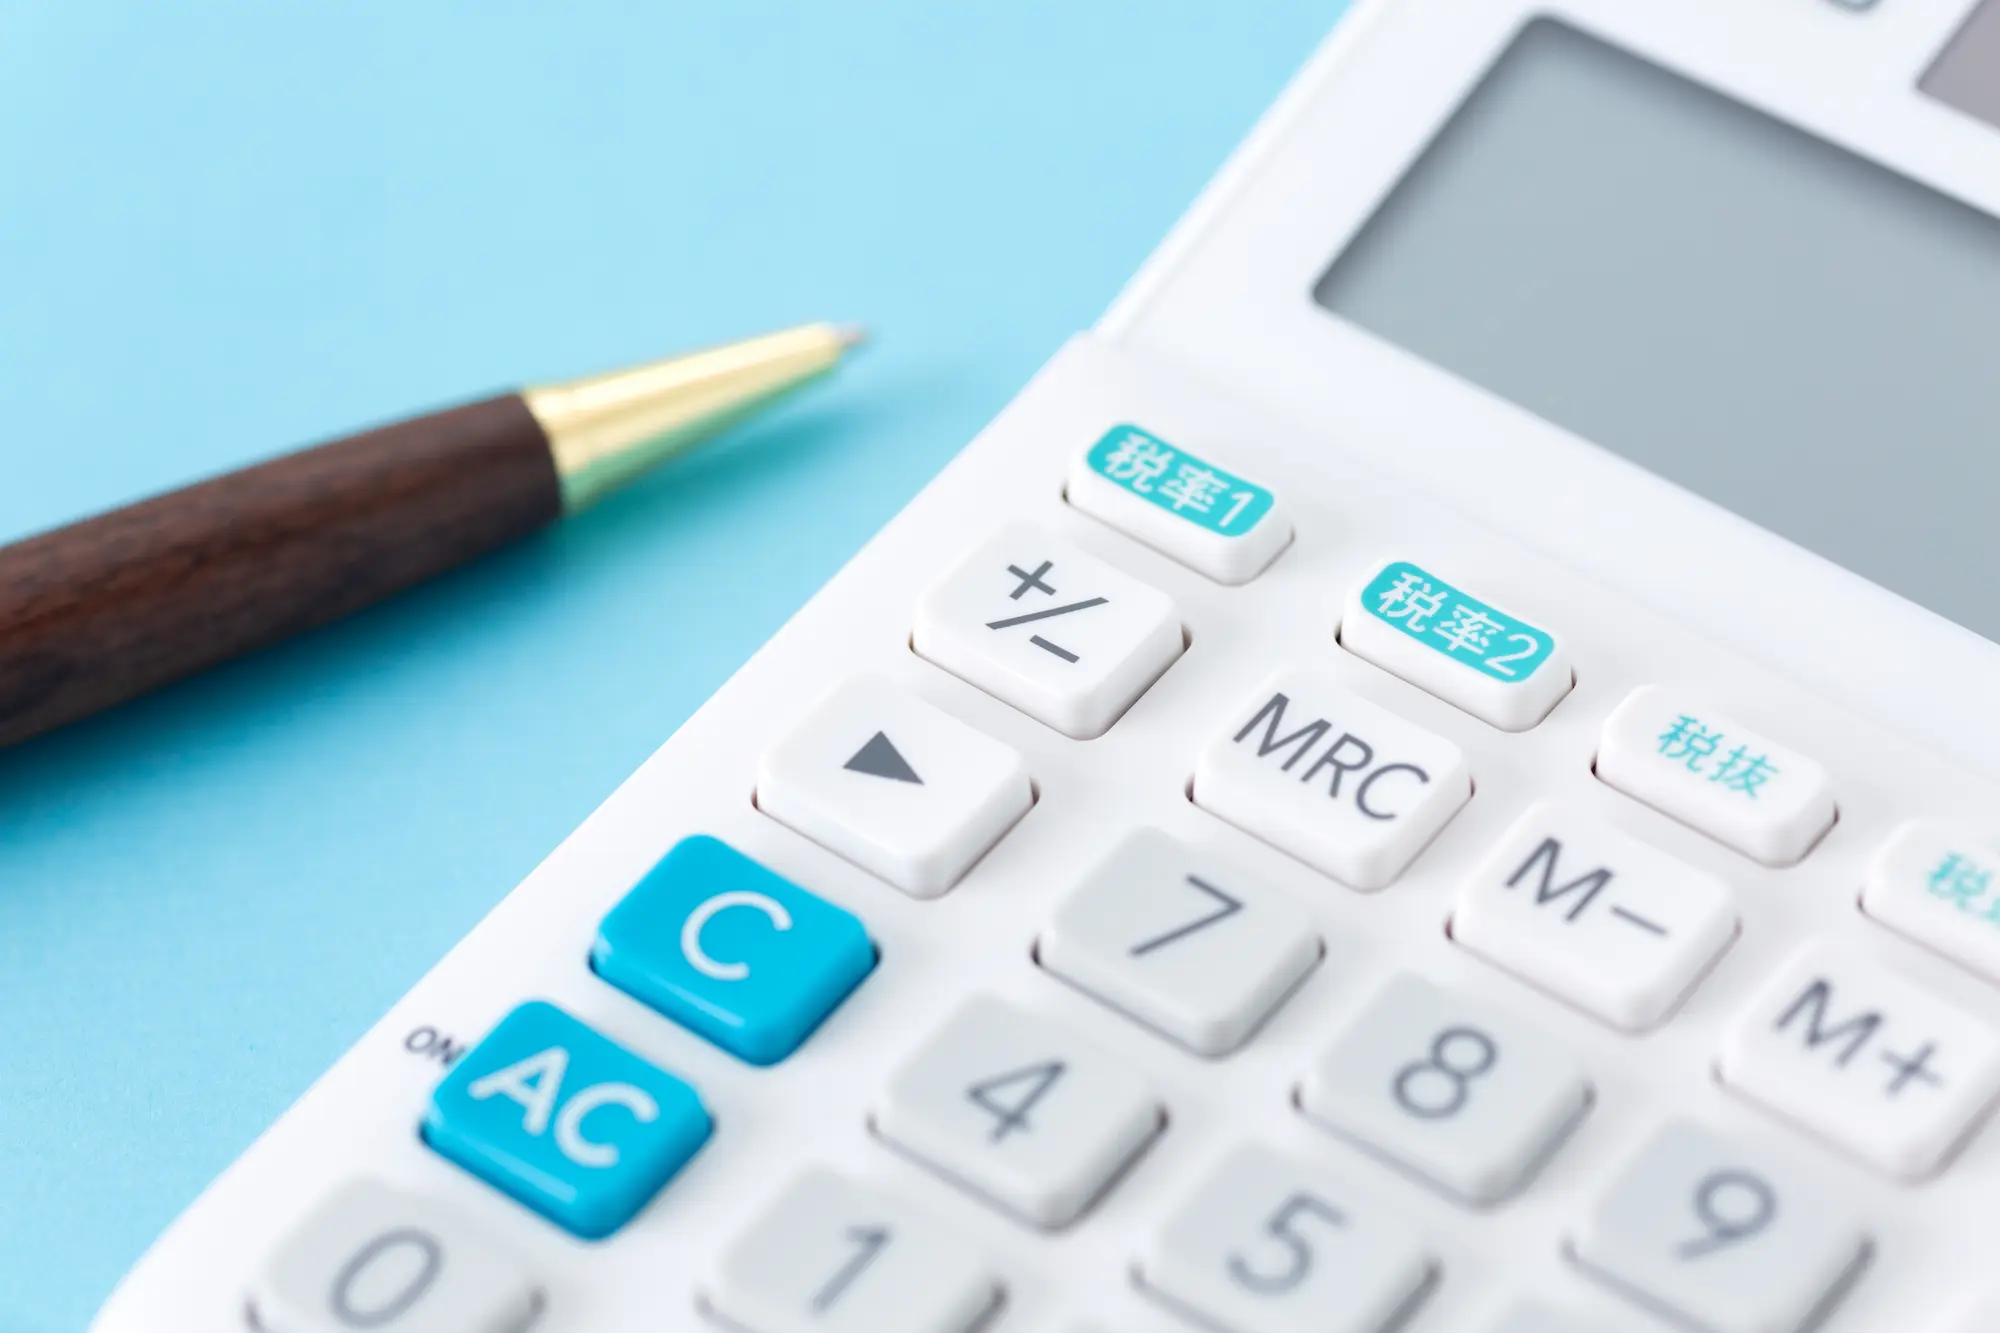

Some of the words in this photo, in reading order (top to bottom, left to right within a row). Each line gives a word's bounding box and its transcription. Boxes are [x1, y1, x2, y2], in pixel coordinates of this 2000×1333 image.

[1103, 433, 1256, 529] 税率1
[1377, 570, 1539, 677] 税率2
[1232, 691, 1432, 823] MRC
[1656, 713, 1781, 800] 税抜
[680, 891, 793, 981] C
[1128, 873, 1245, 957] 7
[1925, 850, 2000, 930] 税
[1391, 1026, 1498, 1121] 8
[1774, 977, 1943, 1097] M+
[469, 1046, 660, 1168] AC
[964, 1059, 1068, 1142] 4
[1225, 1191, 1350, 1298] 5
[1674, 1168, 1780, 1263] 9
[330, 1227, 444, 1329] 0
[810, 1222, 893, 1316] 1
